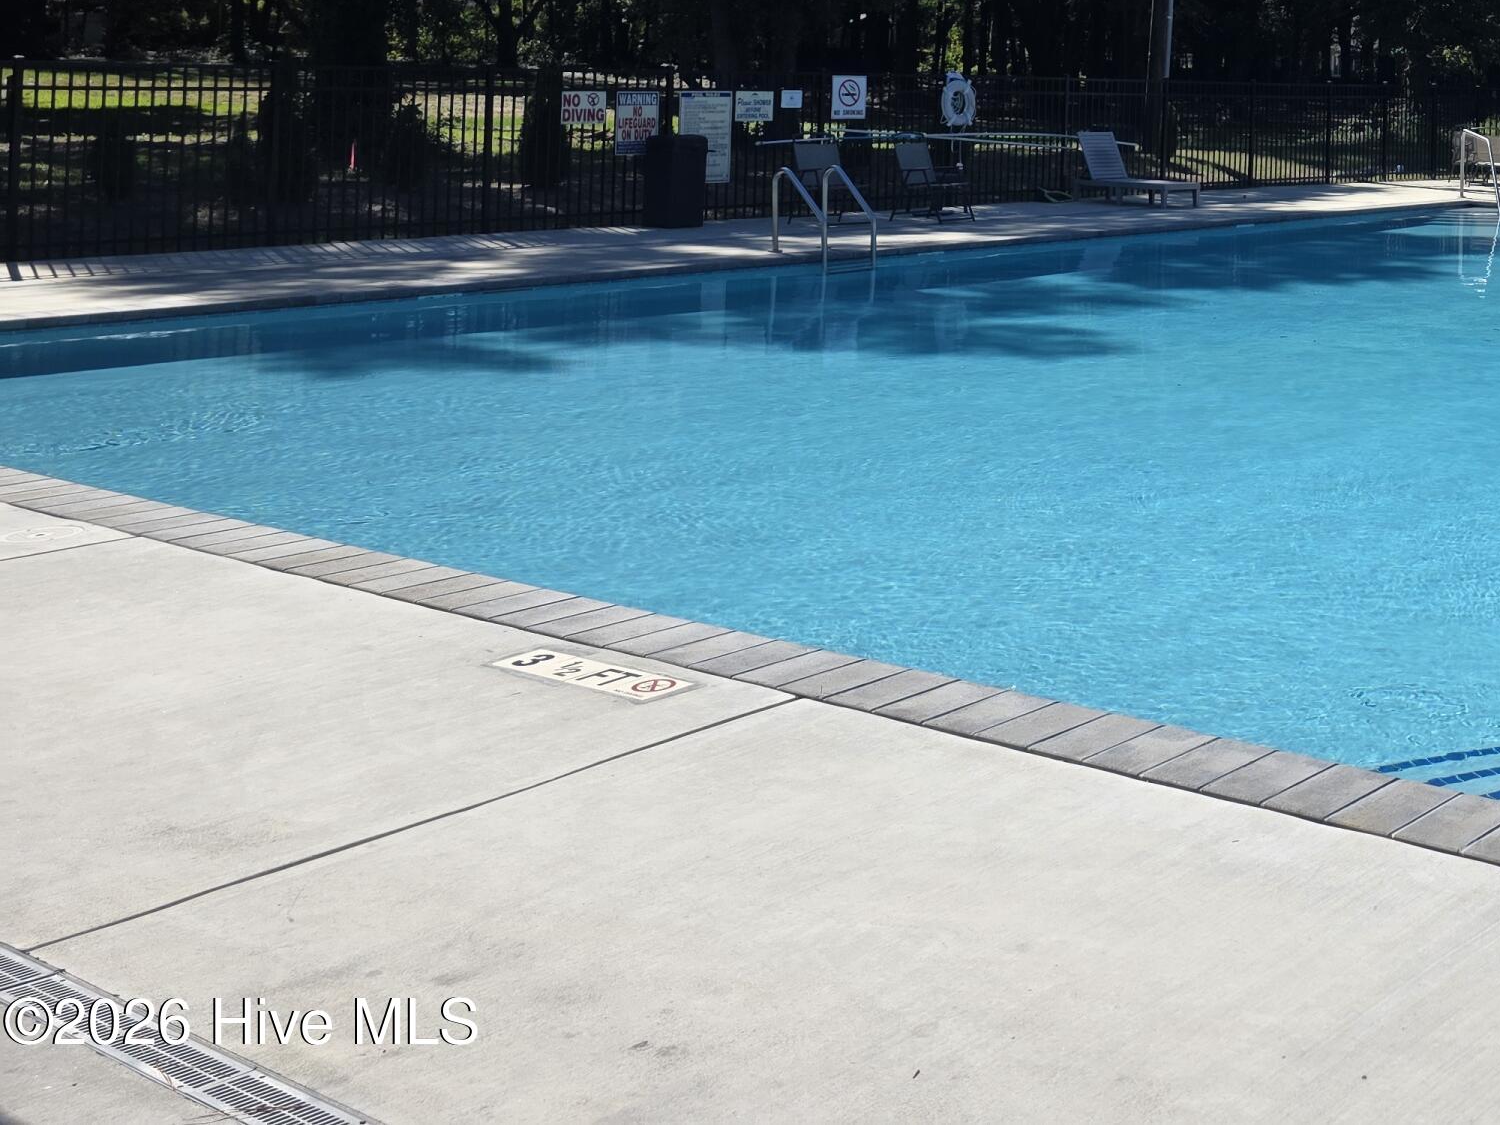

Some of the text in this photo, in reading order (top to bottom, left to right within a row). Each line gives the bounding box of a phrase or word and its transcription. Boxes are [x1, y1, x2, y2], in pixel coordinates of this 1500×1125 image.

[563, 94, 580, 107] NO
[619, 94, 657, 106] WARNING
[562, 109, 604, 122] DIVING
[633, 107, 642, 117] NO
[618, 118, 656, 129] LIFEGUARD
[622, 130, 631, 141] ON
[511, 654, 555, 667] 3
[576, 668, 643, 686] FT
